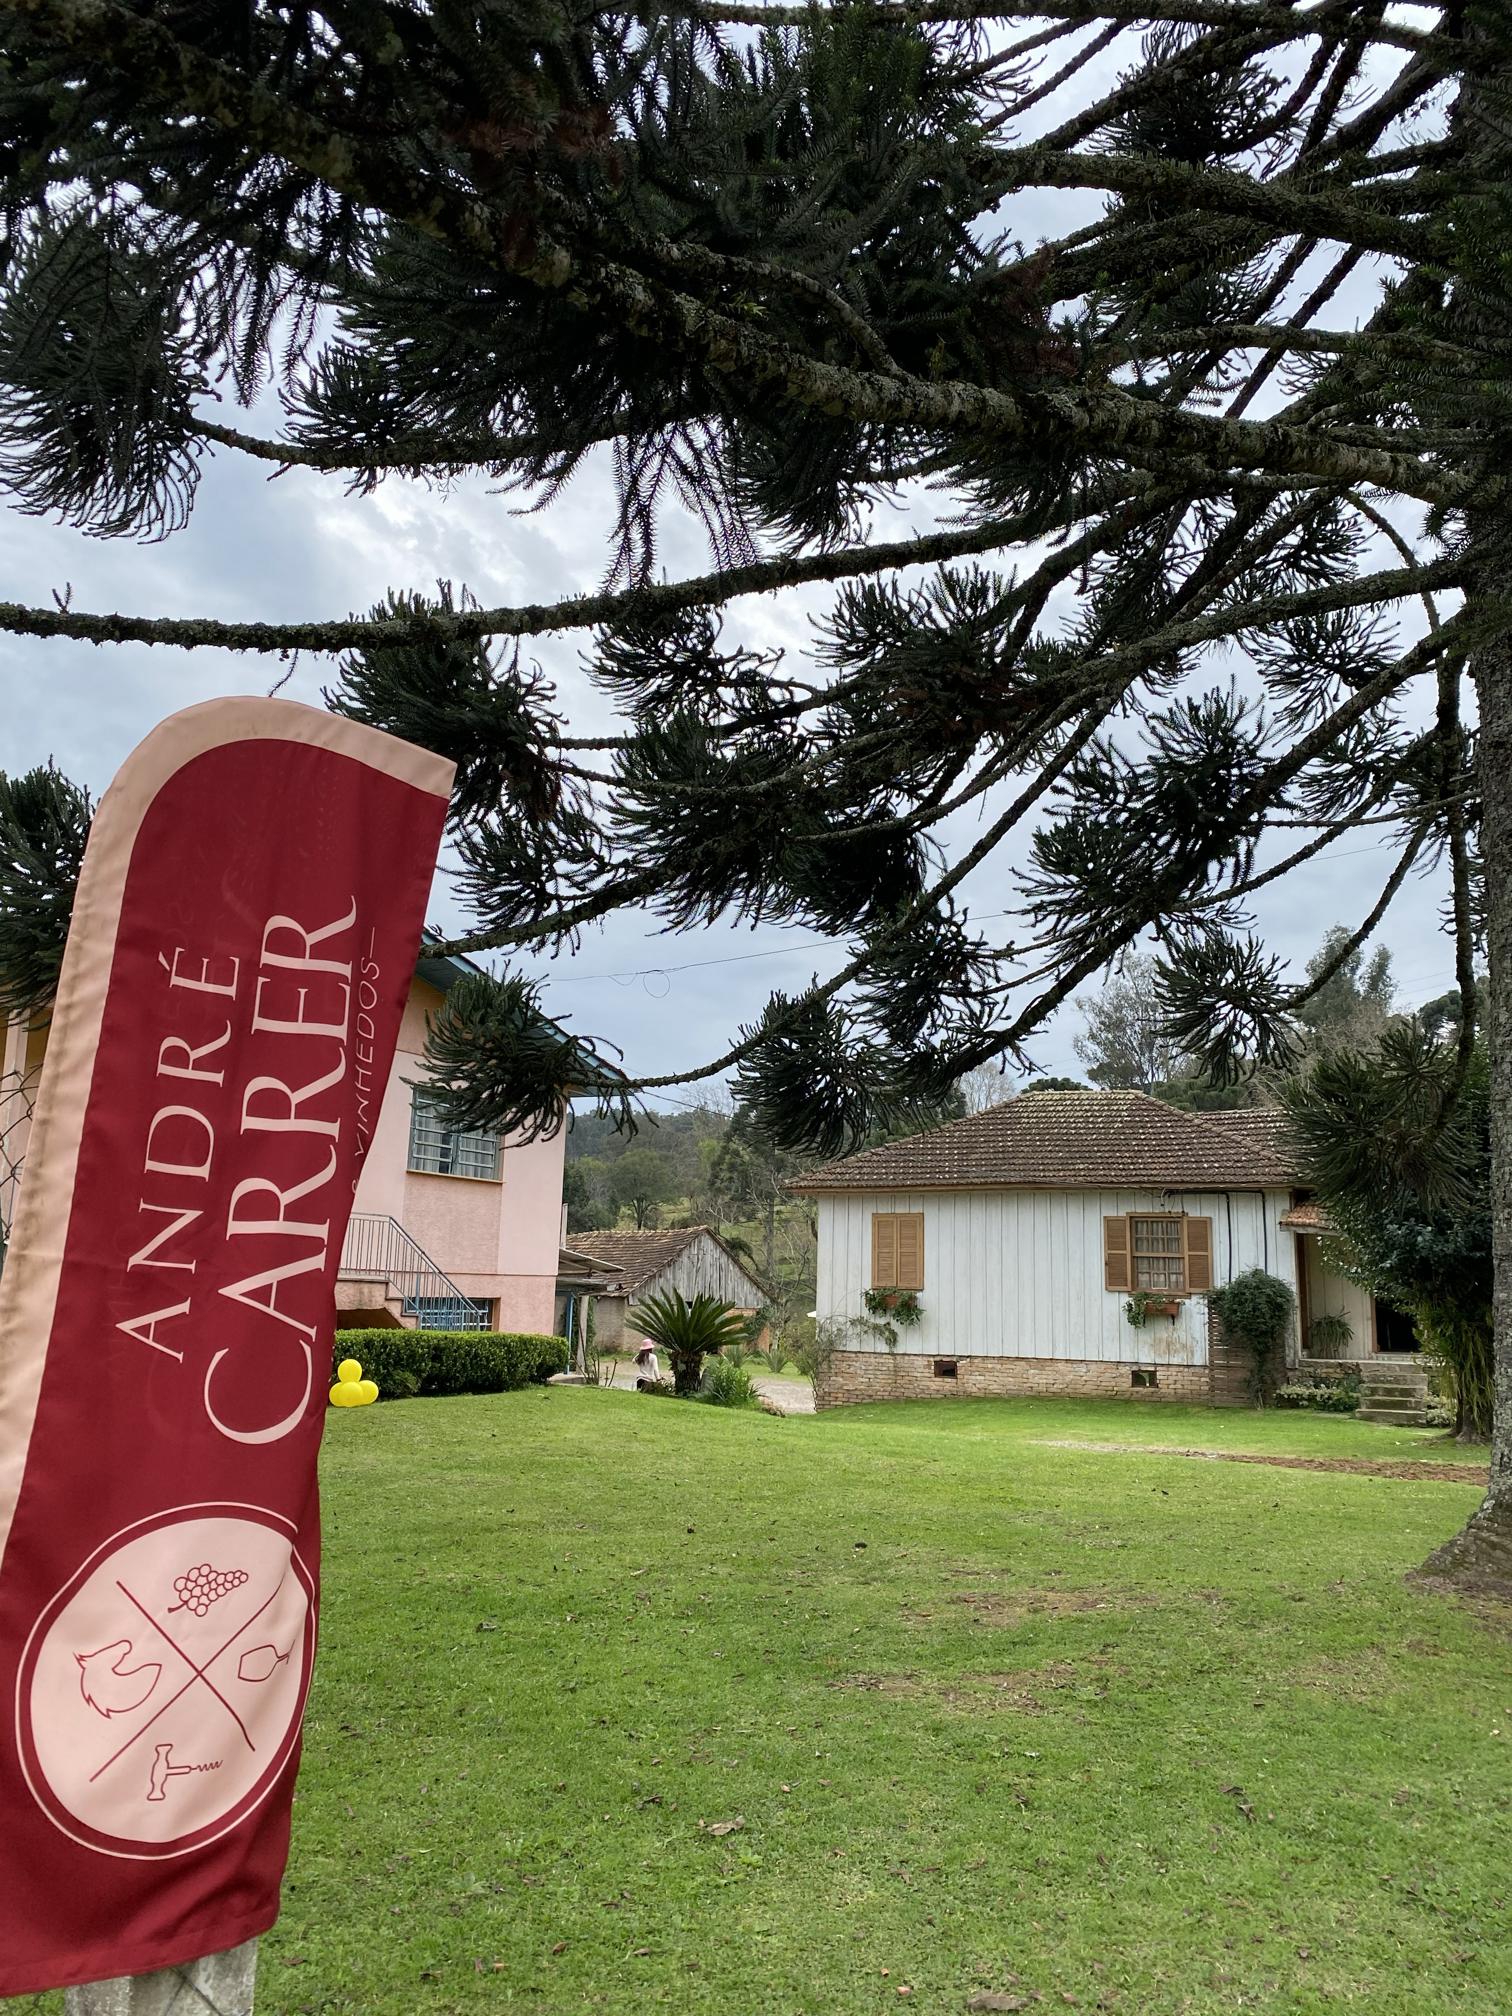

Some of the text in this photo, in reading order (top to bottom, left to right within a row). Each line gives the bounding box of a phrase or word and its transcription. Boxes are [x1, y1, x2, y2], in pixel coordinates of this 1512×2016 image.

[115, 946, 240, 1363] ANDRÉ
[203, 894, 357, 1445] CARRER
[354, 956, 380, 1156] VINHEDOS
